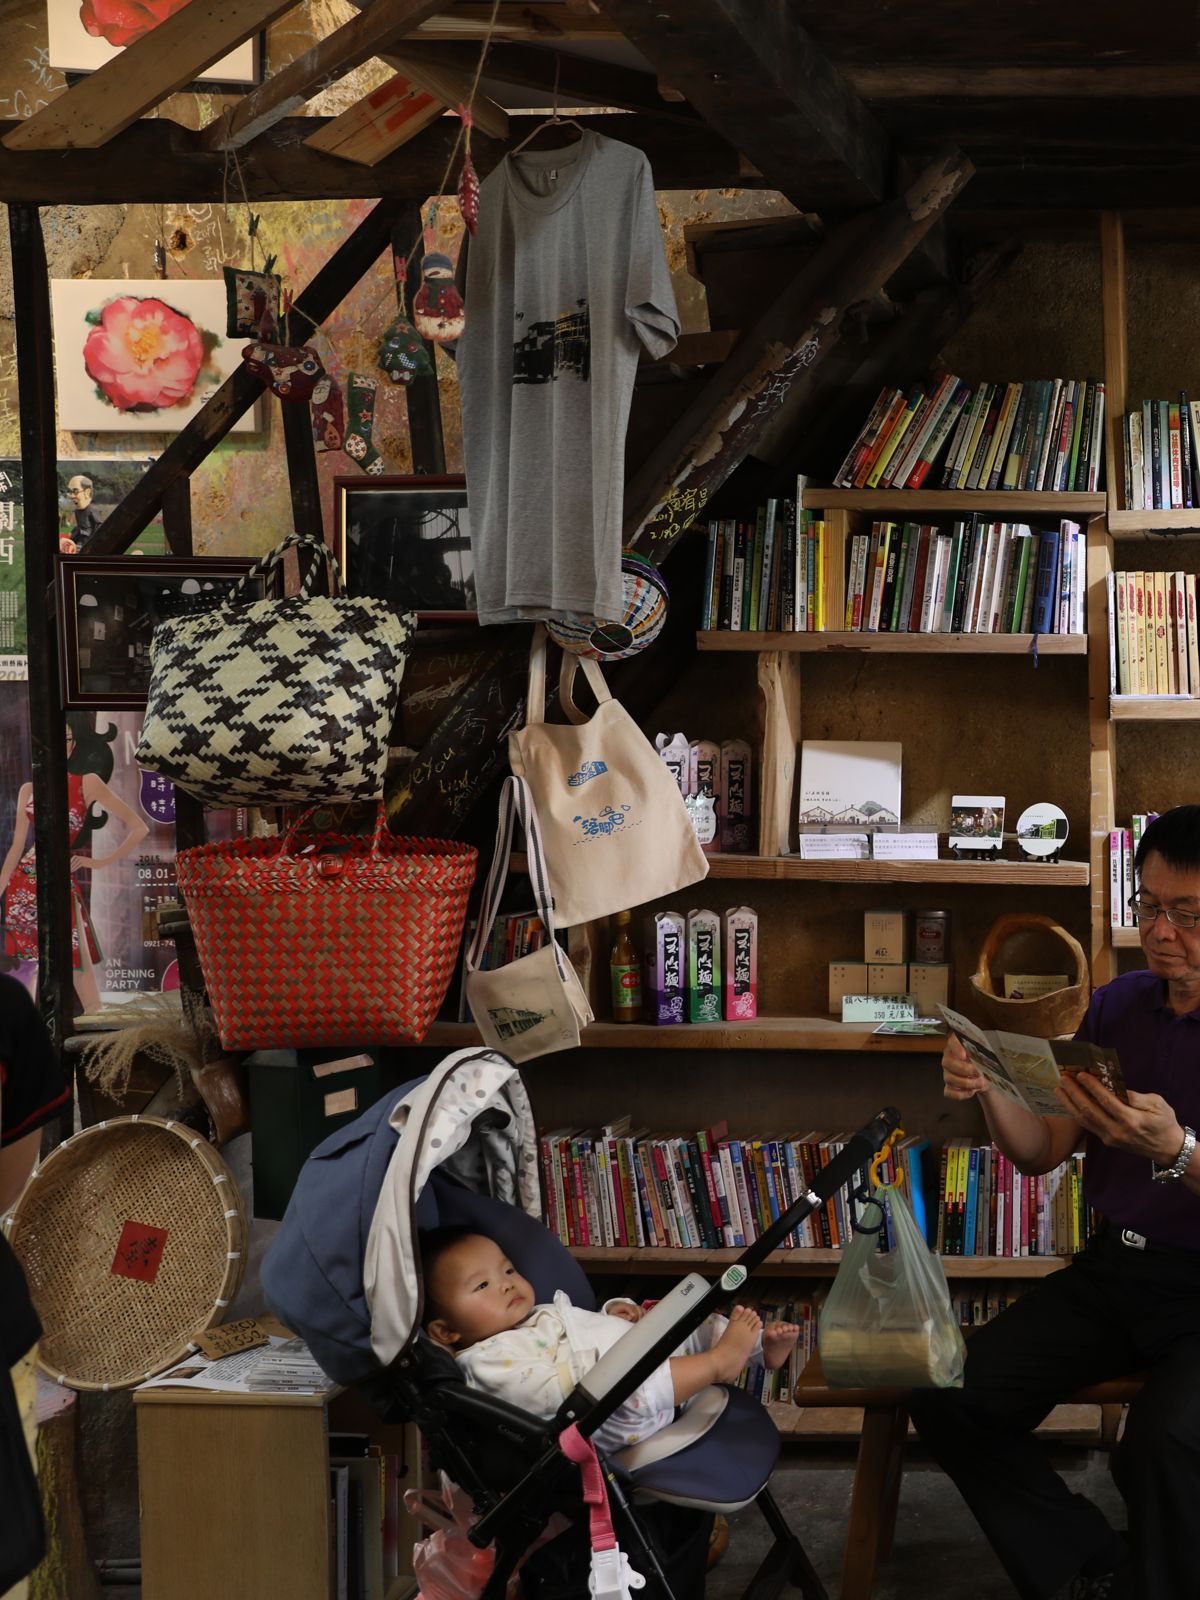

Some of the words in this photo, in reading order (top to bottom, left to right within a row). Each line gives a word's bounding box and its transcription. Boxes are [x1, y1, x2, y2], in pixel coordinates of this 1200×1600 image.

[138, 855, 161, 863] 2015
[105, 958, 121, 968] AN
[105, 968, 156, 979] OPENING
[106, 979, 141, 990] PARTY
